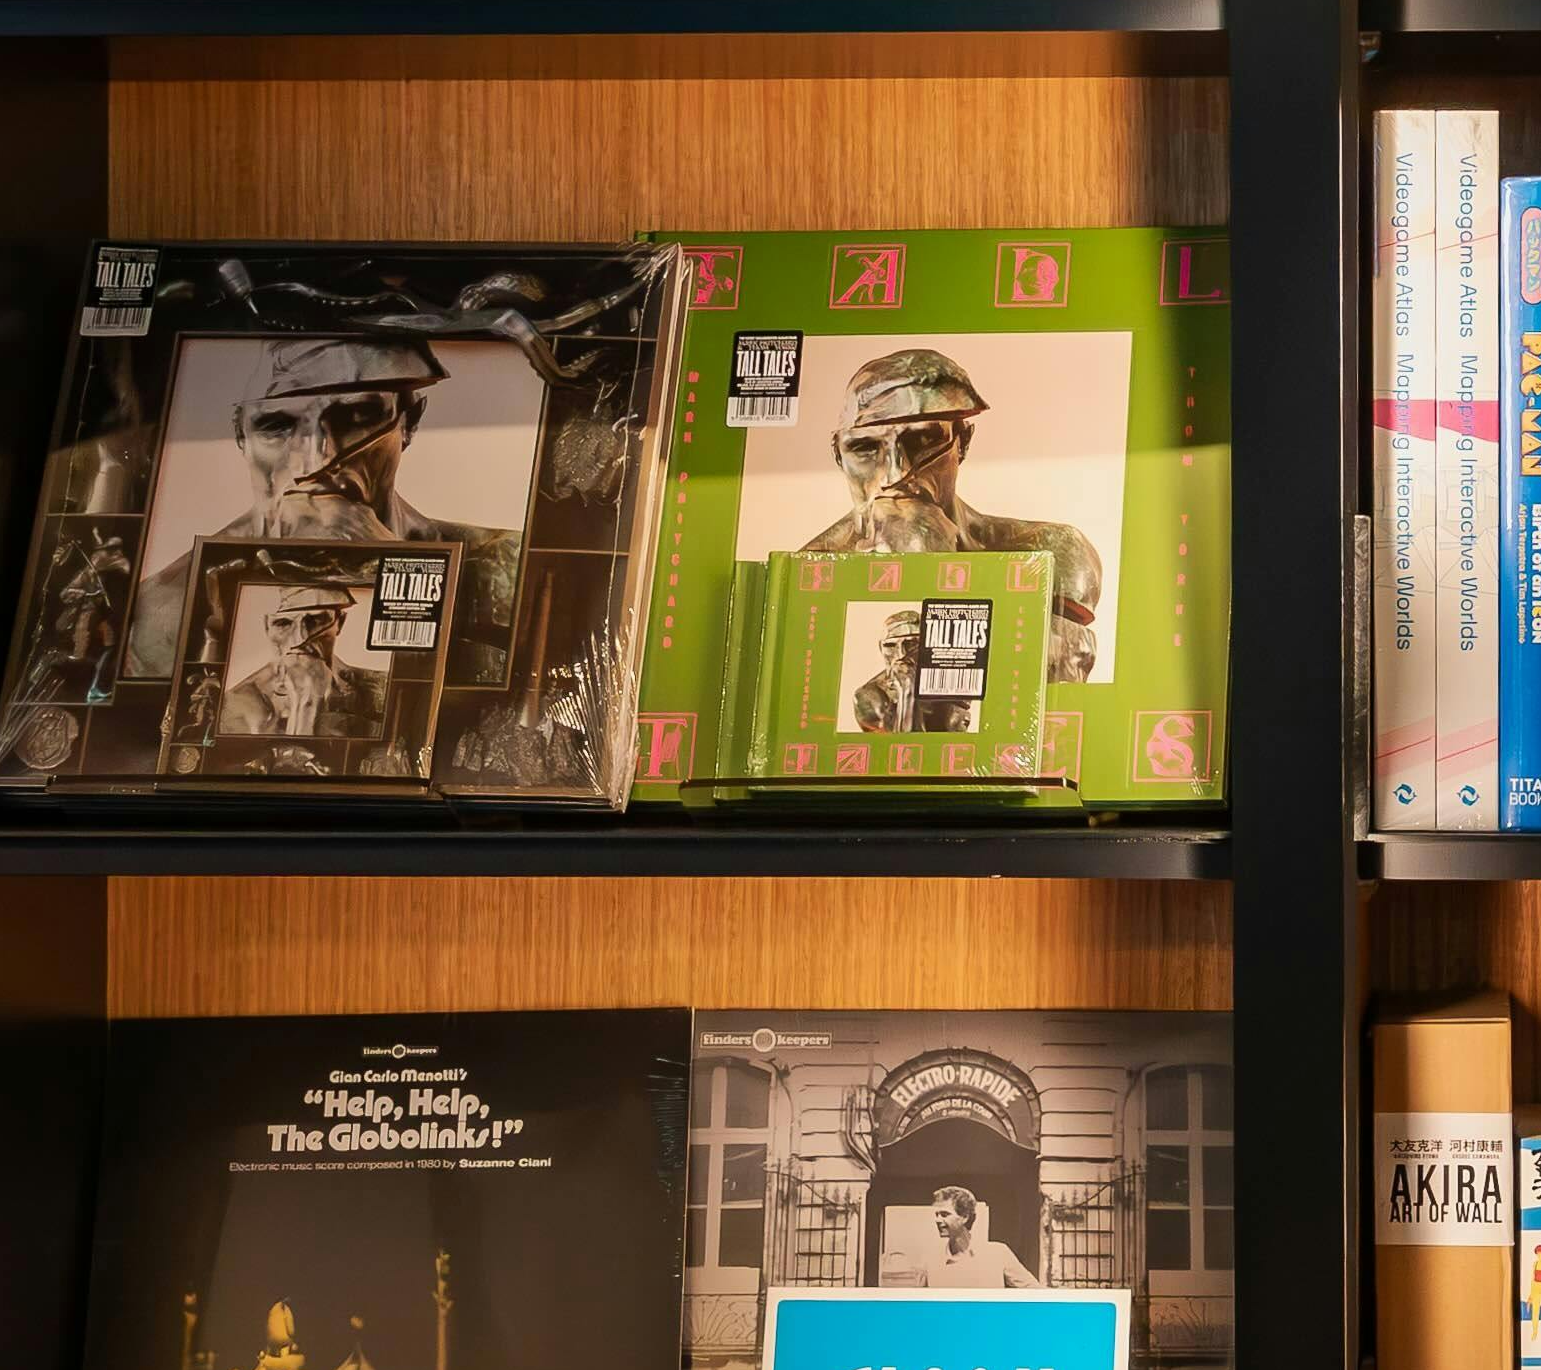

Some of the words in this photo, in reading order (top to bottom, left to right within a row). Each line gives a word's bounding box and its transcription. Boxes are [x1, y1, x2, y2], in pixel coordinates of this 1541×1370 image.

[1454, 152, 1478, 280] Videogame
[1459, 285, 1477, 339] Atlas
[736, 349, 763, 378] TALL
[763, 349, 797, 378] TALES
[1454, 354, 1478, 452] Mapping
[1459, 456, 1475, 571] Interactive
[1459, 577, 1475, 653] Worlds
[304, 1089, 404, 1123] “Help,
[409, 1088, 489, 1122] Help,
[267, 1125, 324, 1152] The
[1390, 1164, 1503, 1205] AKIRA
[1389, 1201, 1422, 1223] ART
[1426, 1201, 1450, 1223] OF
[1455, 1201, 1503, 1224] WALL
